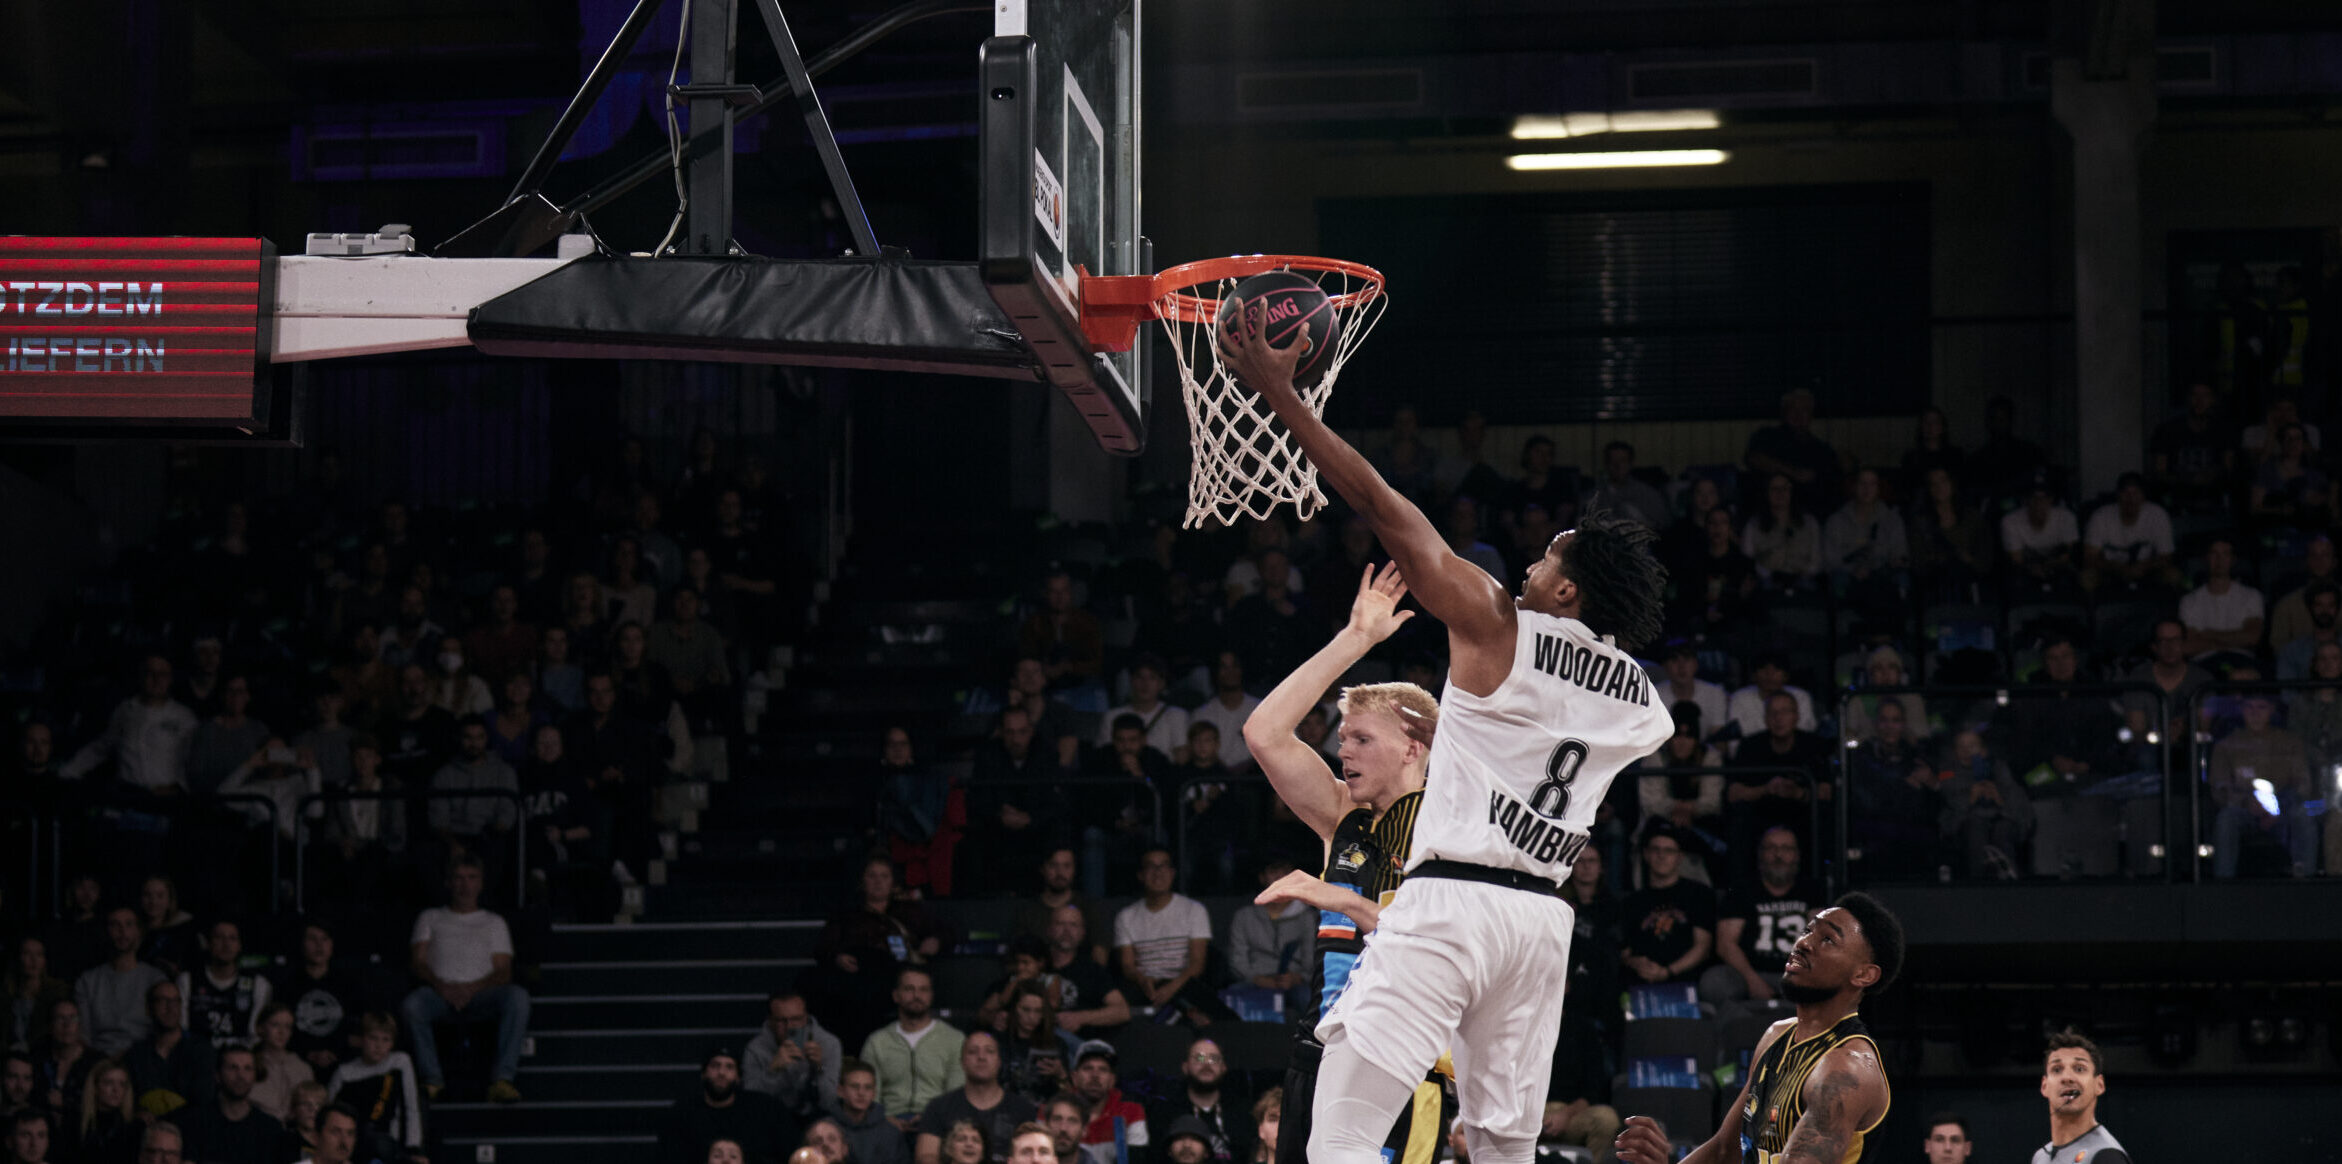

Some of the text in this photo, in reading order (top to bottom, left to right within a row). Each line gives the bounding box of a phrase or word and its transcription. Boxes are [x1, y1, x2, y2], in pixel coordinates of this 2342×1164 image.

[0, 282, 163, 318] TZDEM
[0, 338, 164, 372] IEFERN
[1534, 632, 1650, 707] WOODARD
[1528, 737, 1590, 821] 8
[1754, 914, 1806, 953] 13
